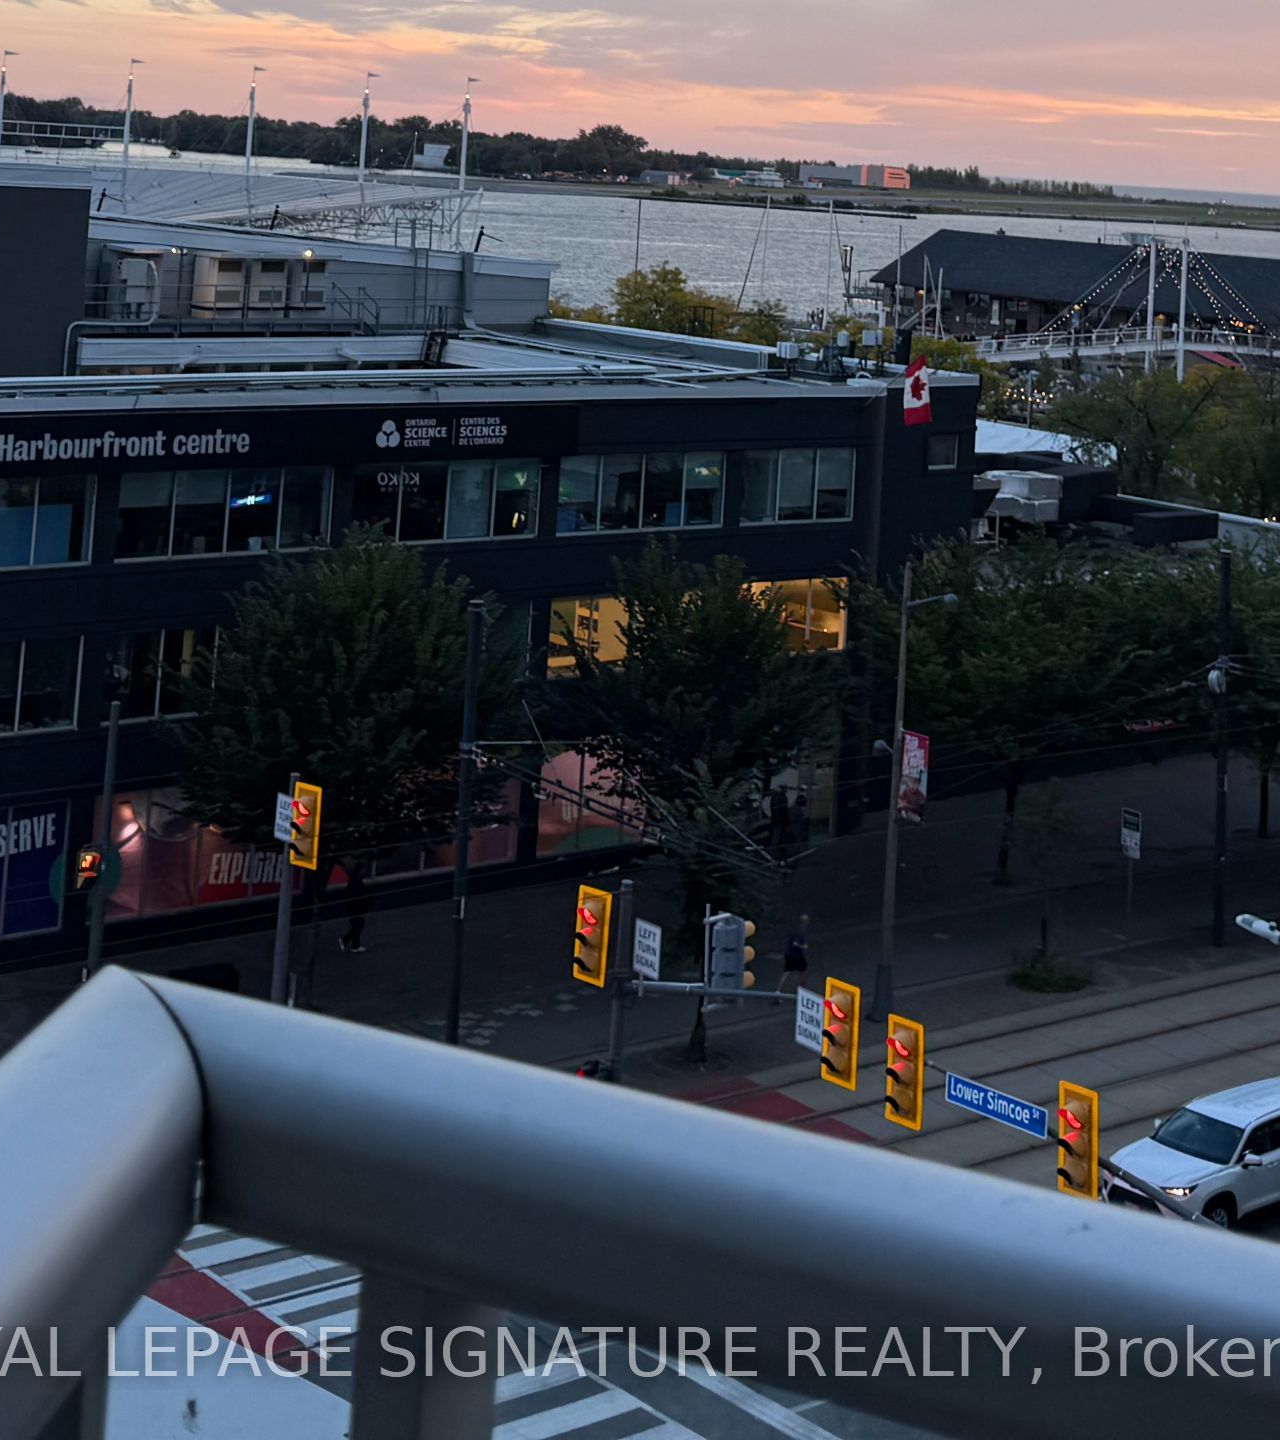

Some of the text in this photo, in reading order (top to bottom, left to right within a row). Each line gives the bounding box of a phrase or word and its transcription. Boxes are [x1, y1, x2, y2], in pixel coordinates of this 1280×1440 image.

[405, 418, 437, 427] ONTARIO
[459, 424, 508, 437] SCIENCES
[404, 426, 448, 439] SCIENCE
[172, 428, 250, 456] centre
[403, 438, 431, 448] CENTRE
[638, 926, 657, 943] LEFT
[800, 995, 820, 1014] LEFT
[800, 1010, 820, 1029] TURN
[950, 1077, 1040, 1124] Lower Simcoe St
